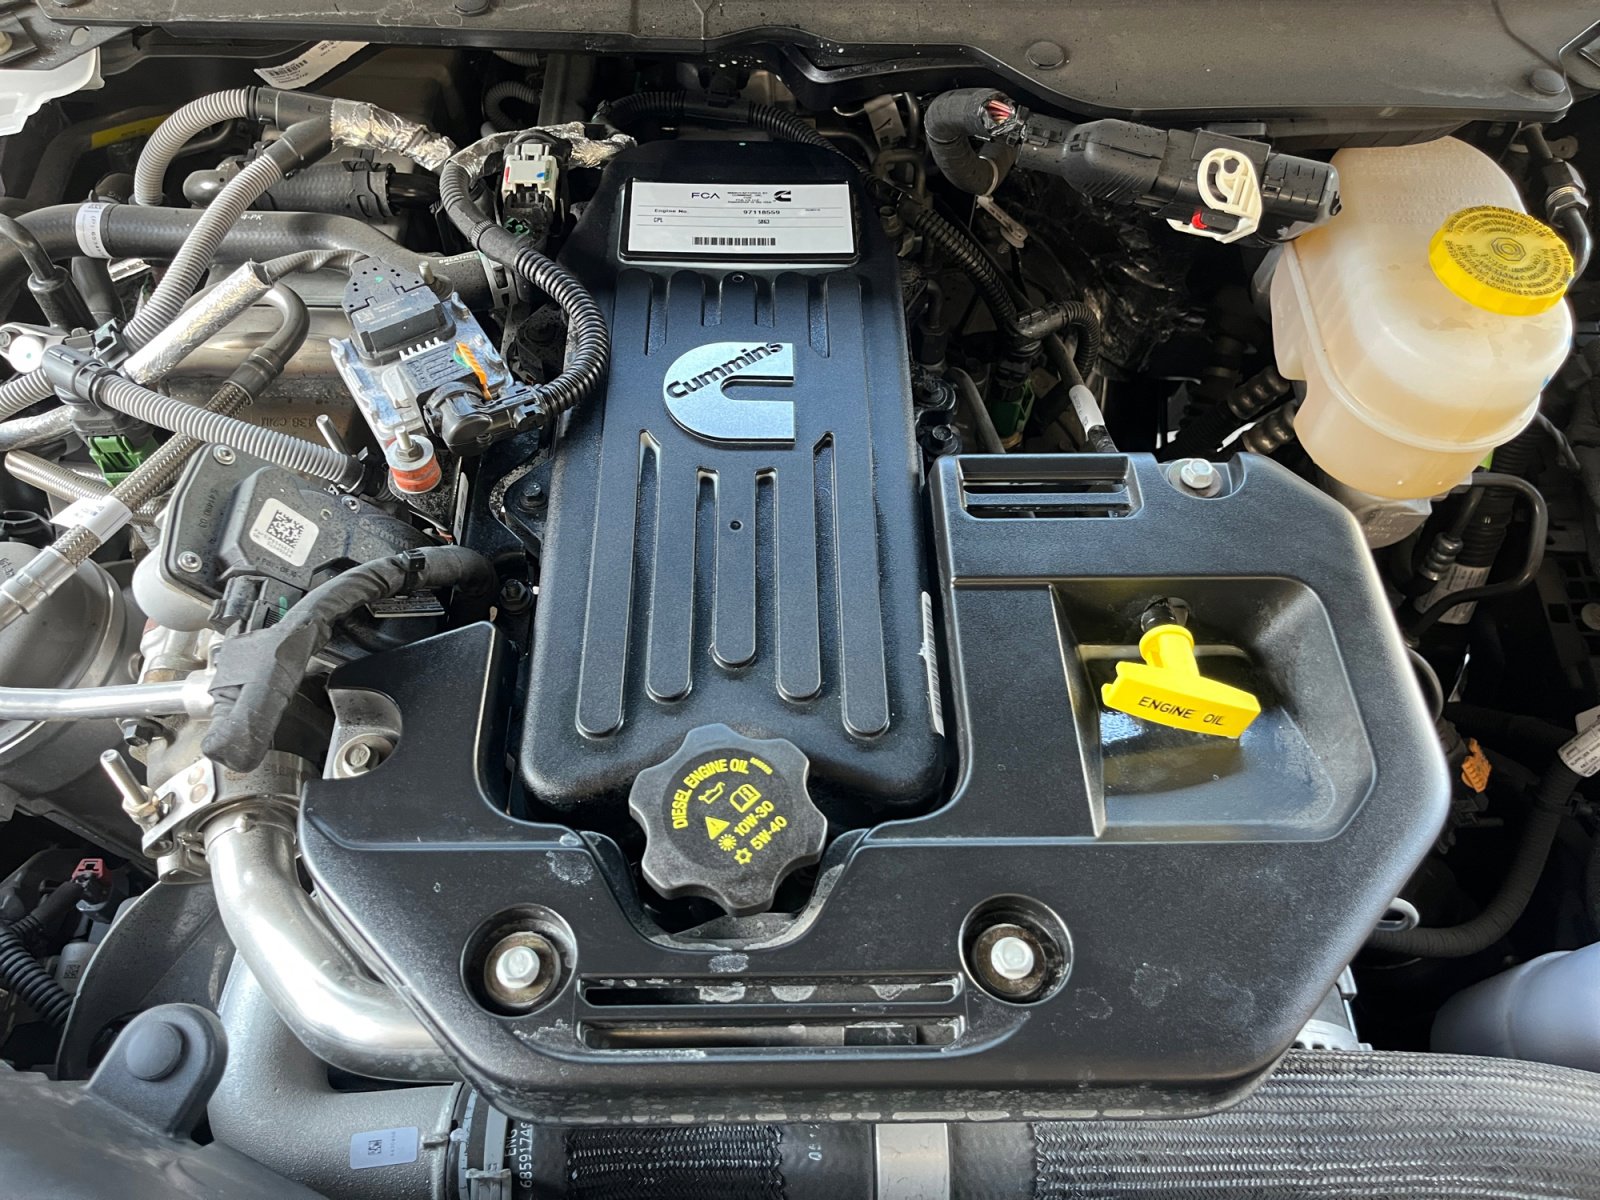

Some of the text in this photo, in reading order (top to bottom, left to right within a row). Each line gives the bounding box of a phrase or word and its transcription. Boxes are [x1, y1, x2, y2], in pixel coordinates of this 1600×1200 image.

[666, 343, 783, 398] Cummins
[1138, 696, 1225, 726] ENGINE OIL
[671, 789, 693, 829] DIESEL
[683, 758, 728, 789] ENGINE
[730, 758, 750, 774] OIL
[734, 800, 774, 836] 10W-30
[750, 816, 788, 850] 5W-40
